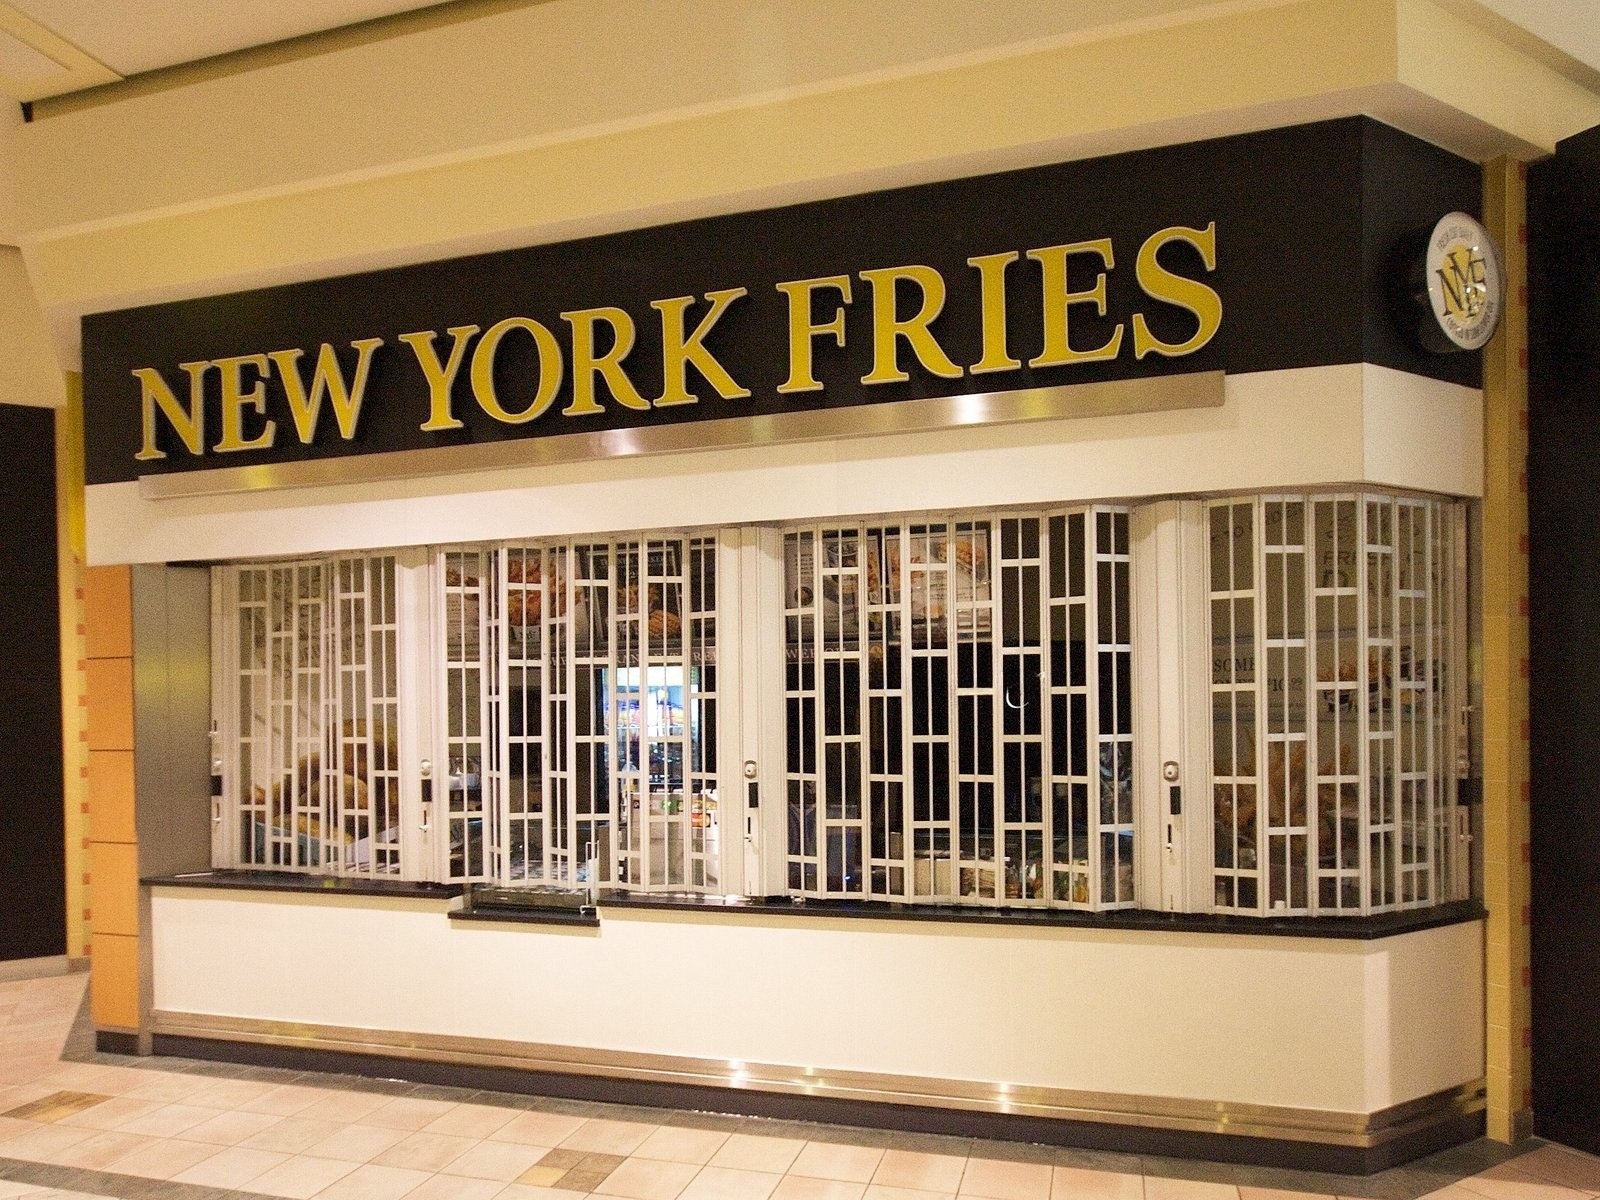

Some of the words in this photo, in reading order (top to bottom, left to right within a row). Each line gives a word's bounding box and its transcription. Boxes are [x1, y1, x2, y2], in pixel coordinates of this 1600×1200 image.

[132, 338, 384, 461] NEW
[399, 287, 751, 432] YORK
[775, 221, 1223, 394] FRIES
